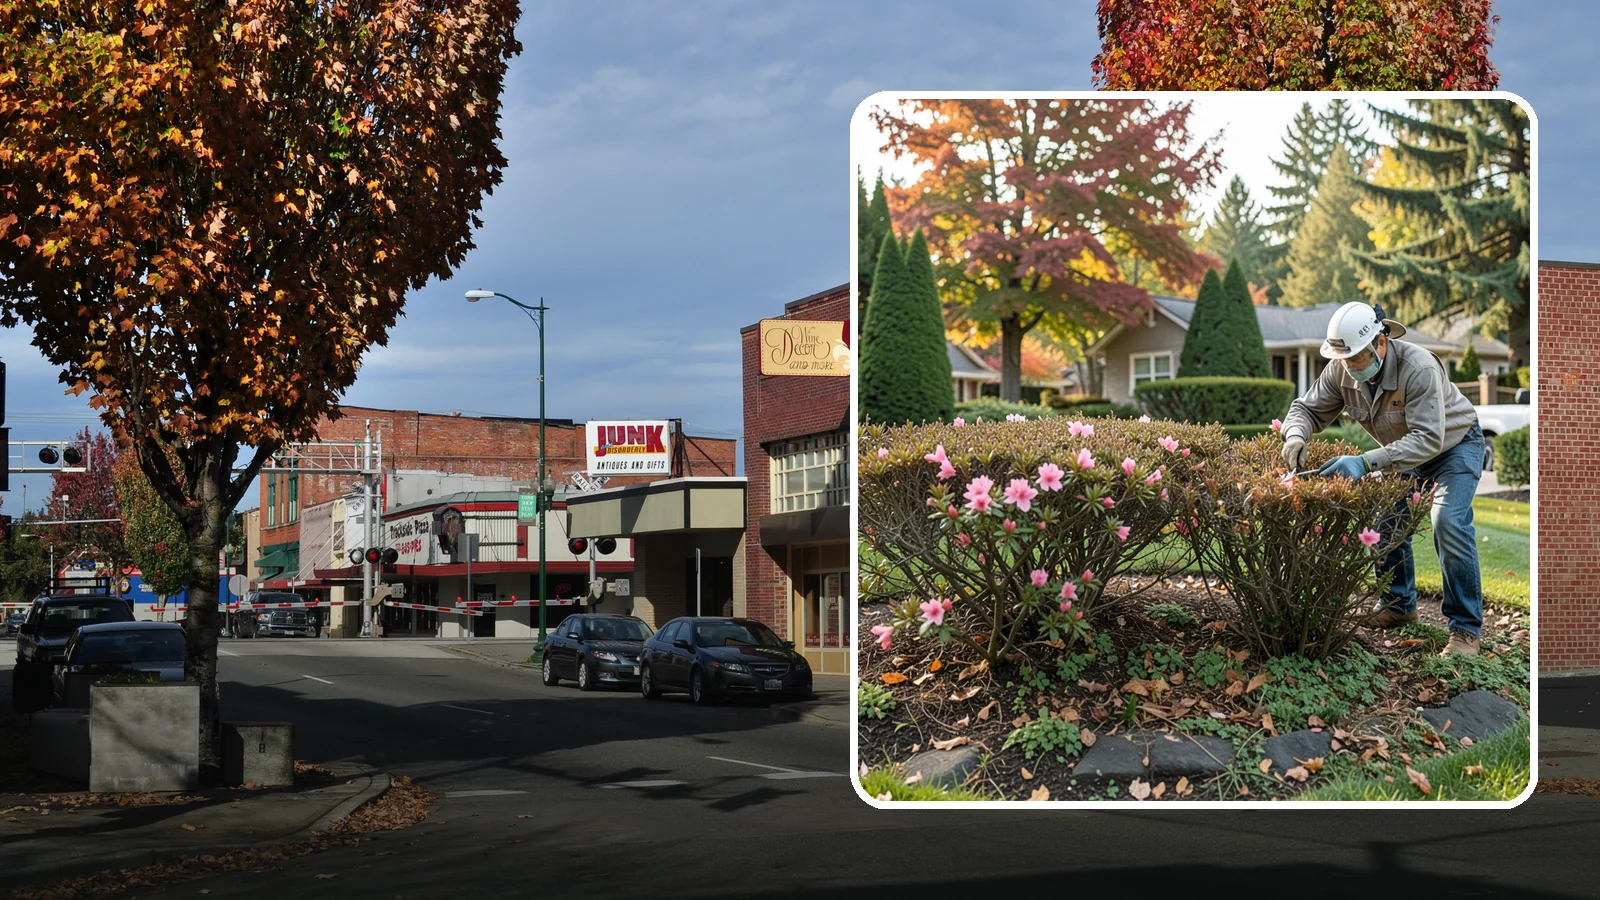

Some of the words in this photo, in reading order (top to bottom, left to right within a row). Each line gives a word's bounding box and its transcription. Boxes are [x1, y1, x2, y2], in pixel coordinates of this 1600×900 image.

[596, 425, 665, 457] JUNK
[607, 446, 645, 454] DISORDERLY
[597, 461, 628, 469] ANTIQUES
[631, 461, 644, 469] AND
[647, 460, 665, 469] GIFTS
[573, 473, 589, 492] RAIL
[414, 519, 429, 535] Pizza
